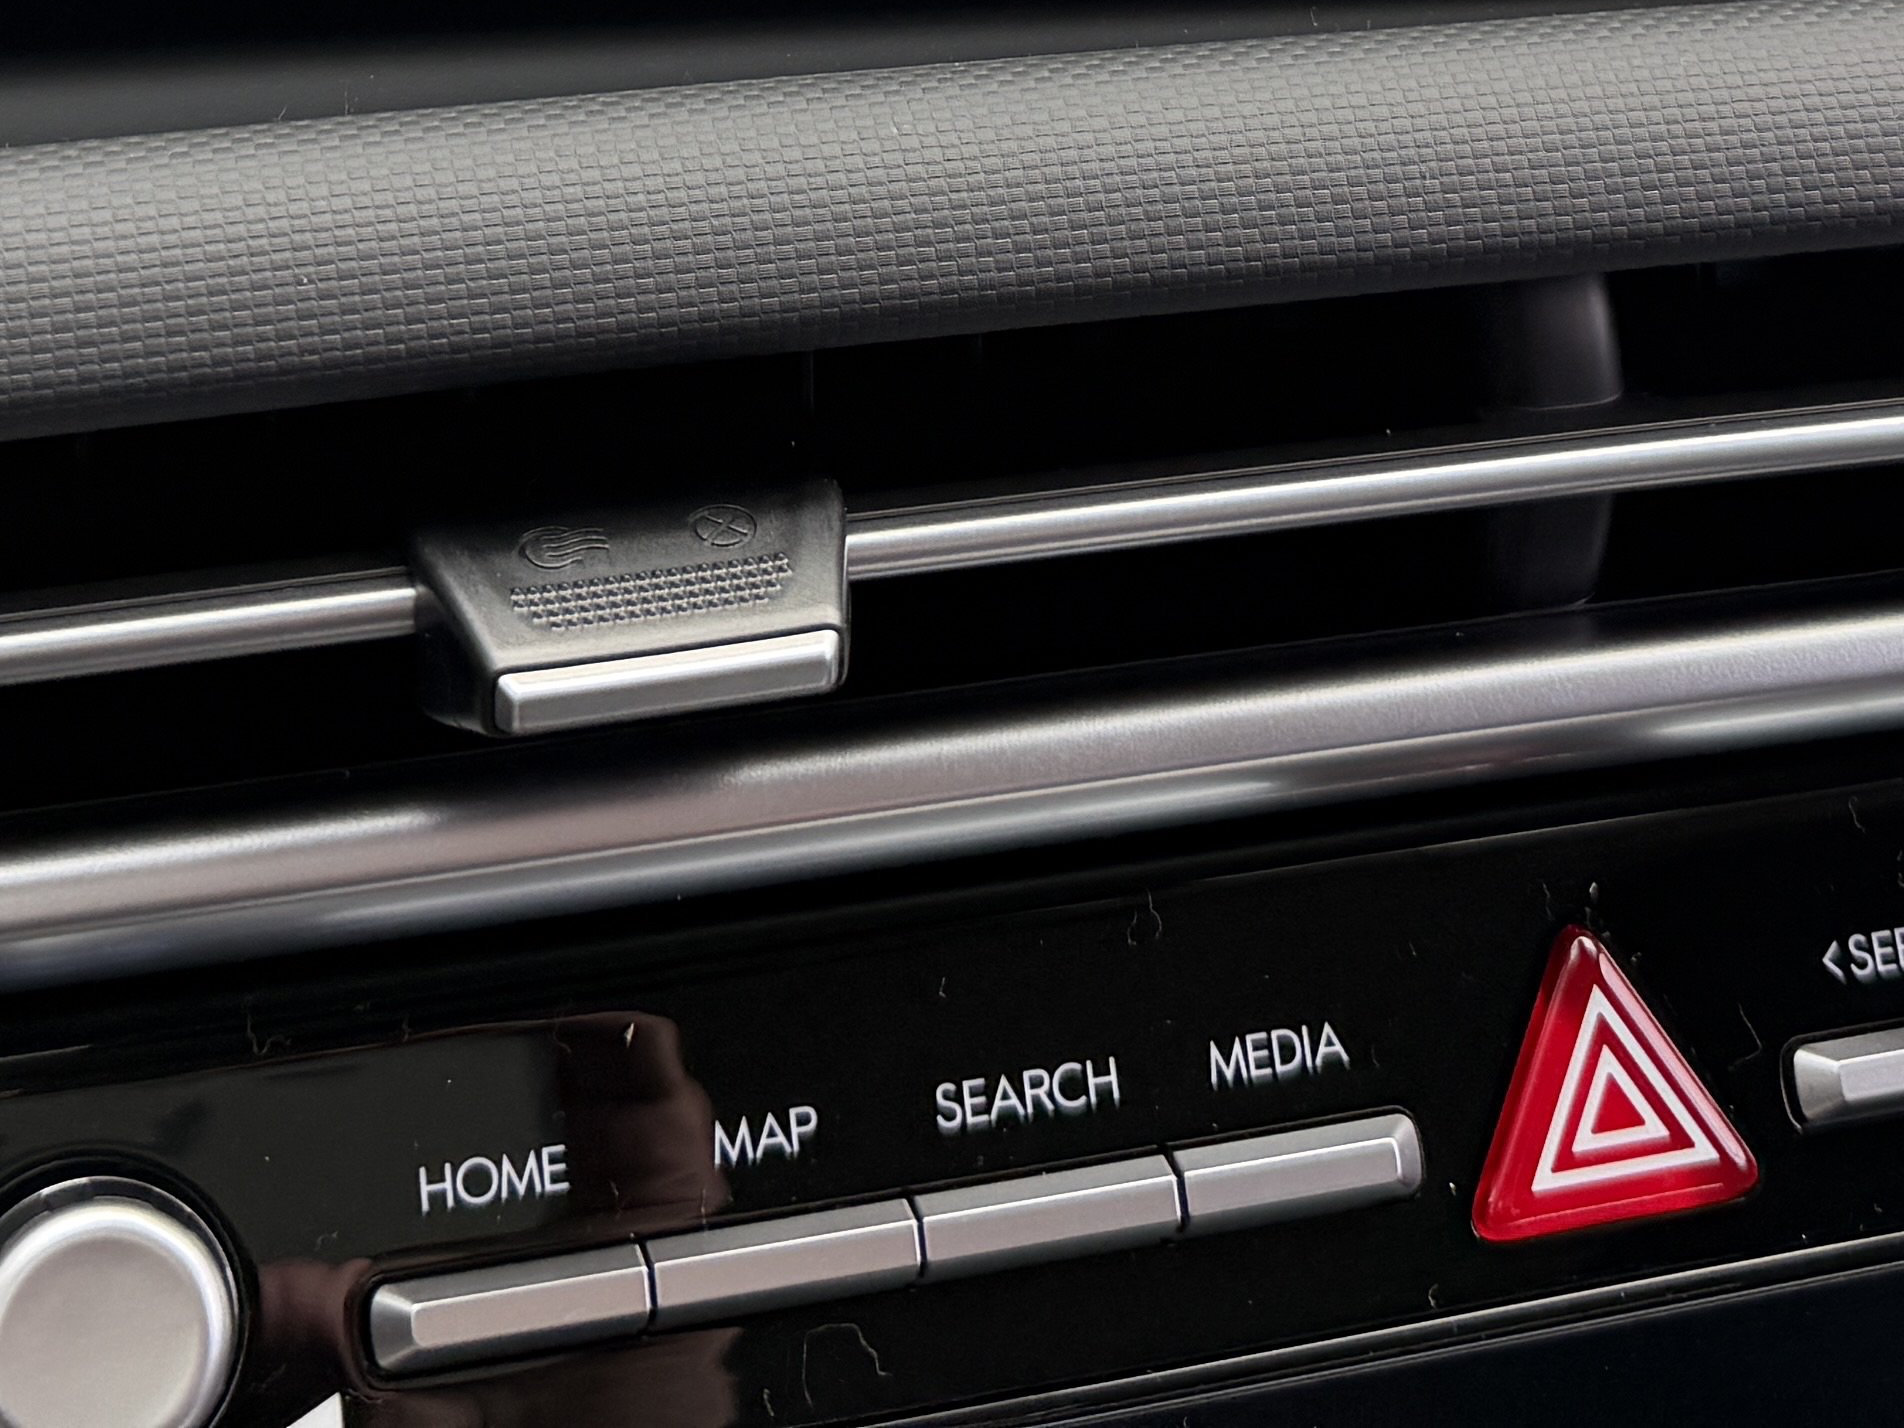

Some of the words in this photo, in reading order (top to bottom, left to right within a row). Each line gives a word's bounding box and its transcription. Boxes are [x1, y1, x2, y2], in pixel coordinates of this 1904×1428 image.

[1208, 1019, 1351, 1090] MEDIA
[934, 1055, 1122, 1133] SEARCH
[713, 1104, 820, 1168] MAP
[418, 1143, 571, 1214] HOME
